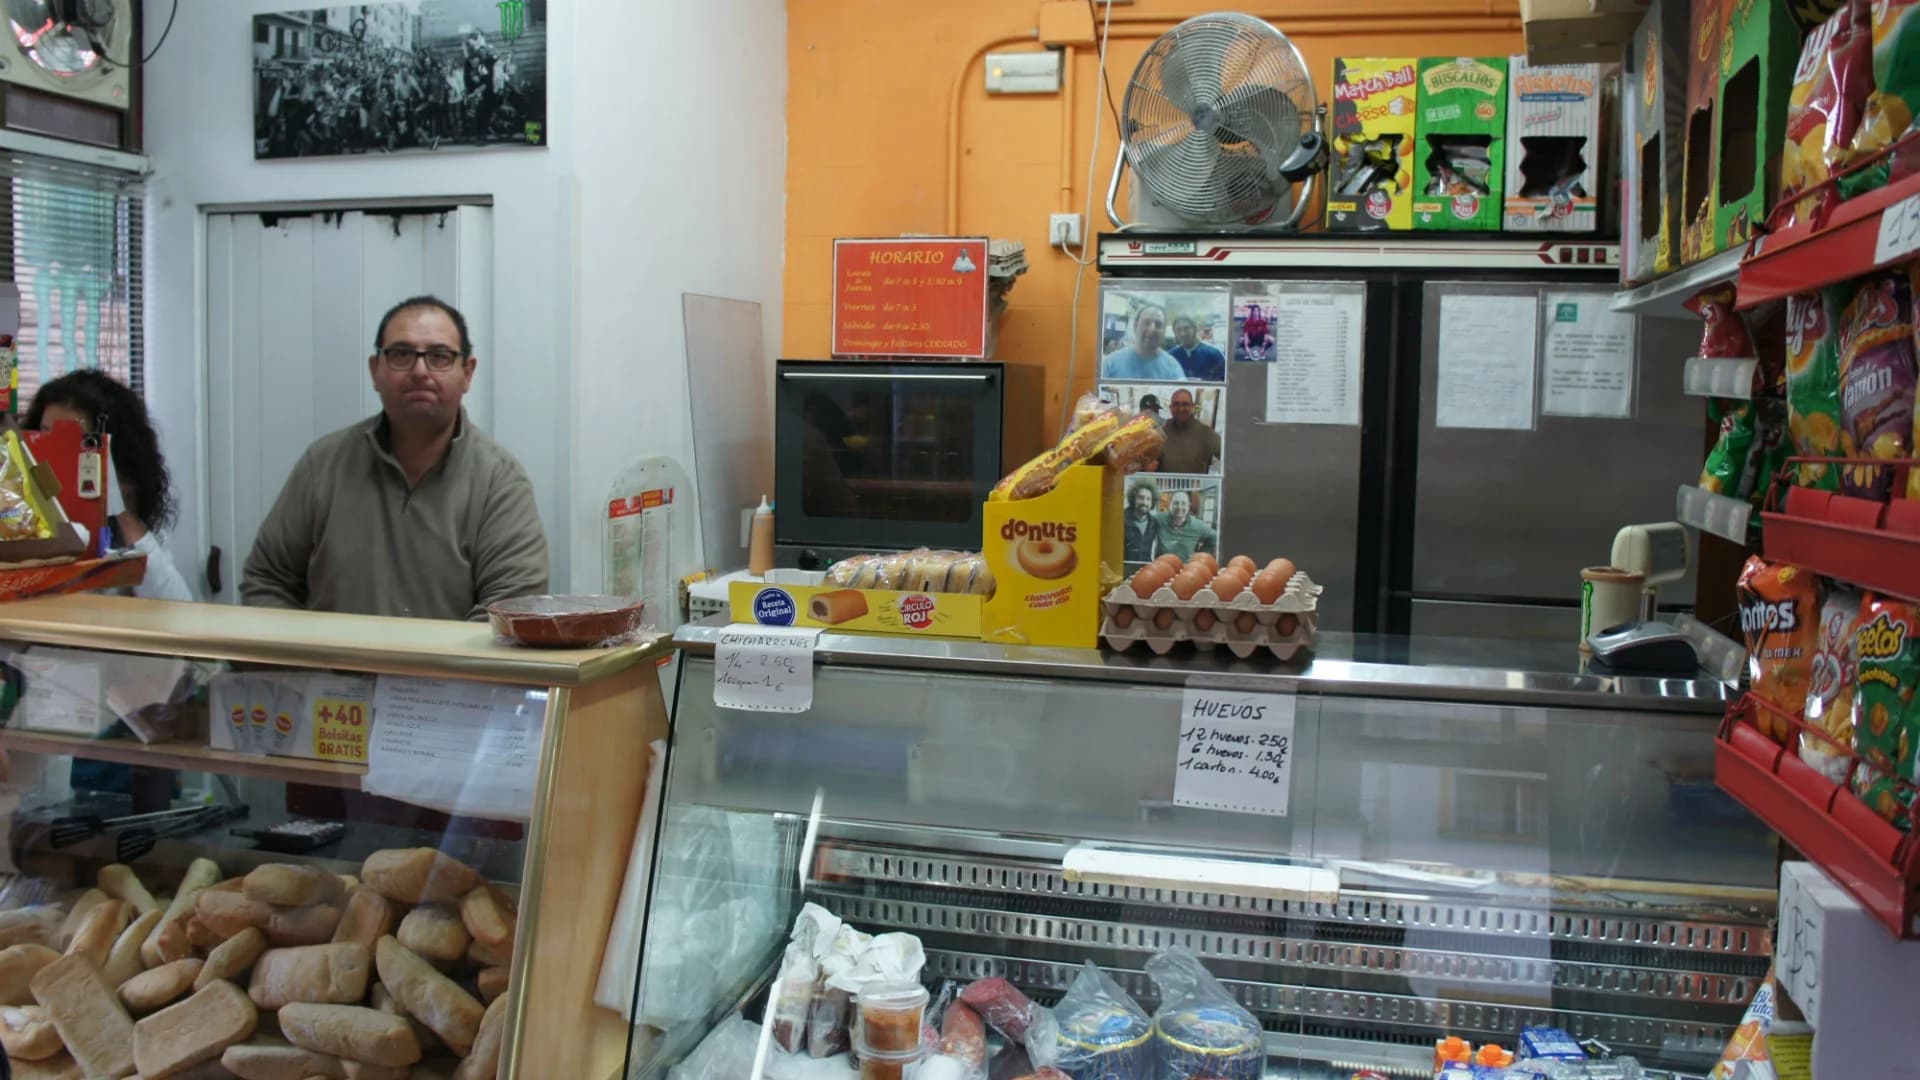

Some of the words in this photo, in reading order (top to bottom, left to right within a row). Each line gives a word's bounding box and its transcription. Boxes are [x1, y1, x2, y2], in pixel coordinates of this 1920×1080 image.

[1335, 77, 1383, 99] Match
[1384, 67, 1412, 87] Ball
[1335, 105, 1388, 128] Cheese
[869, 250, 944, 264] HORARIO
[1001, 519, 1077, 542] donuts
[757, 607, 793, 619] Original
[761, 600, 786, 611] Receta
[1738, 600, 1796, 632] oritos
[1192, 698, 1268, 720] HUEVOS
[319, 727, 362, 743] Bolsitas
[1180, 727, 1207, 742] 12
[319, 742, 362, 758] GRATIS
[1191, 743, 1204, 754] 6
